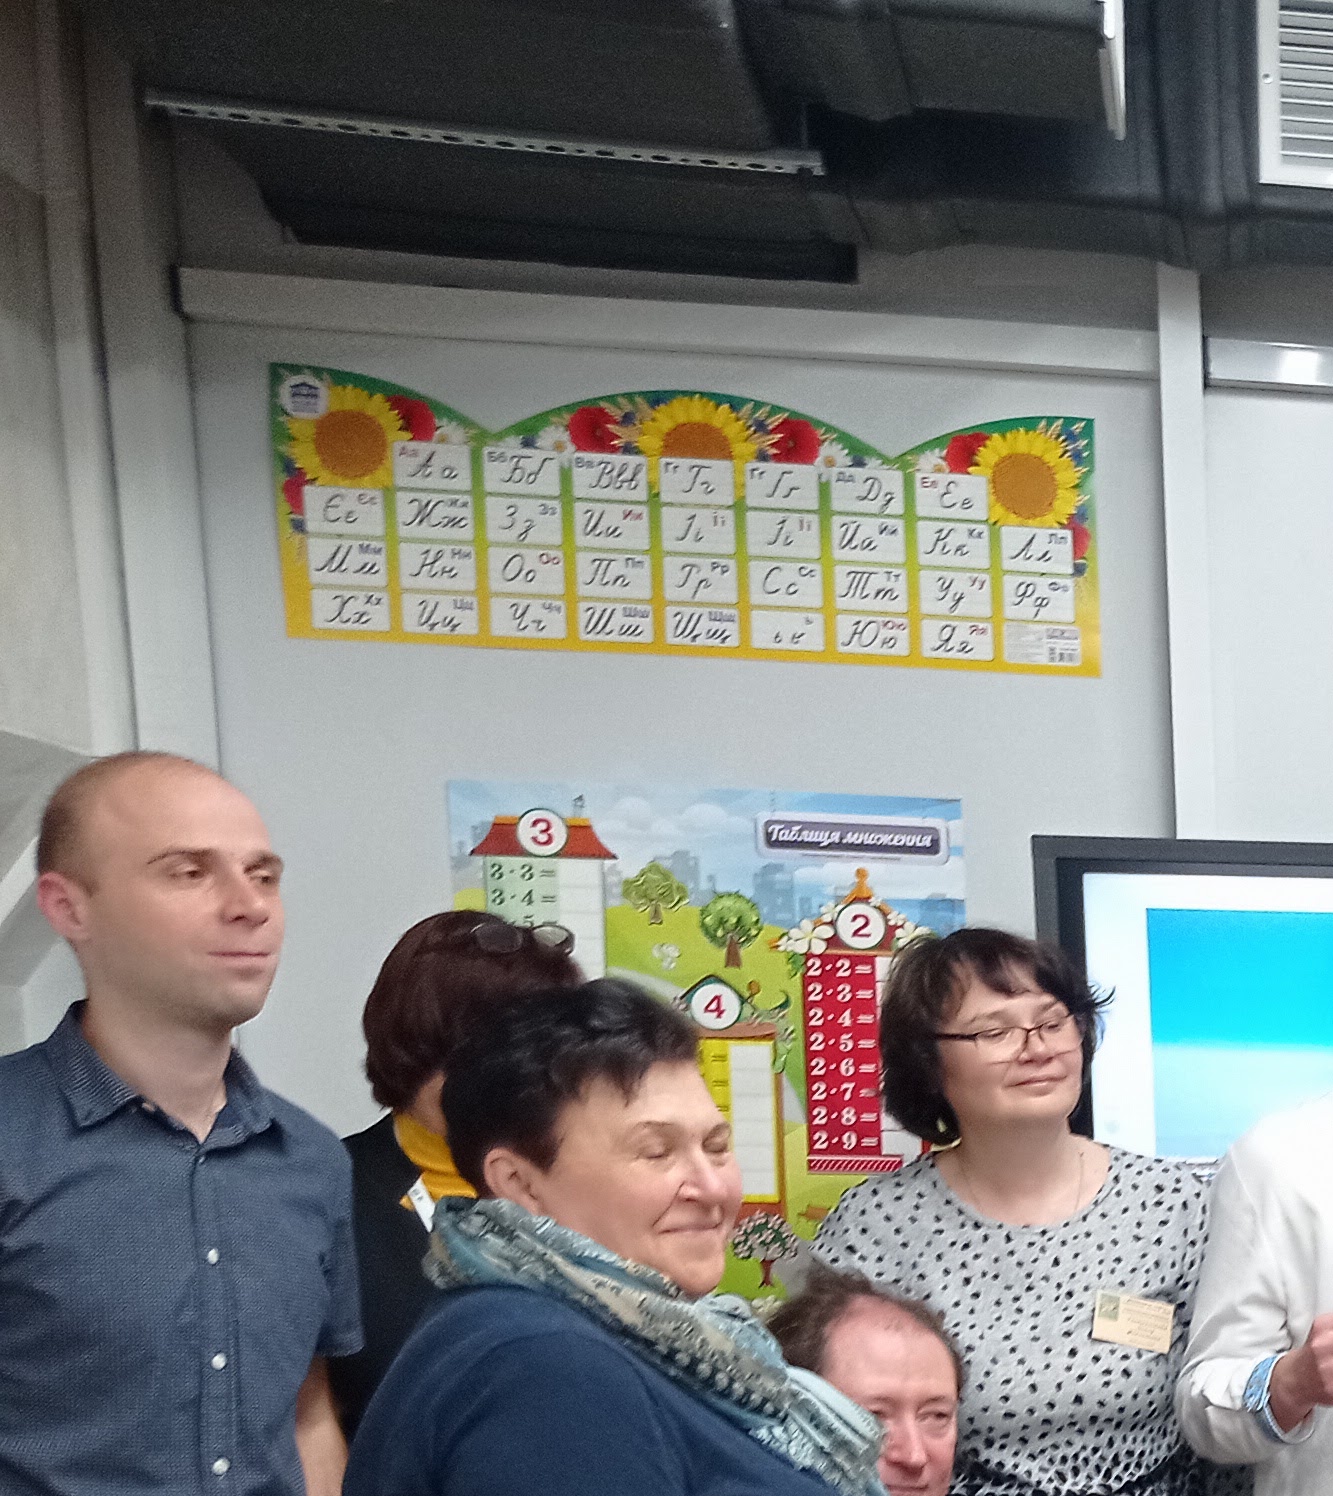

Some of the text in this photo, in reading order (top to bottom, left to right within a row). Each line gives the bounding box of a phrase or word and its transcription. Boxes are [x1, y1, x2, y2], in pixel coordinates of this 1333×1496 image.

[530, 818, 554, 846] 3
[768, 825, 932, 847] Таблиця множення
[851, 914, 872, 938] 2
[704, 994, 725, 1019] 4
